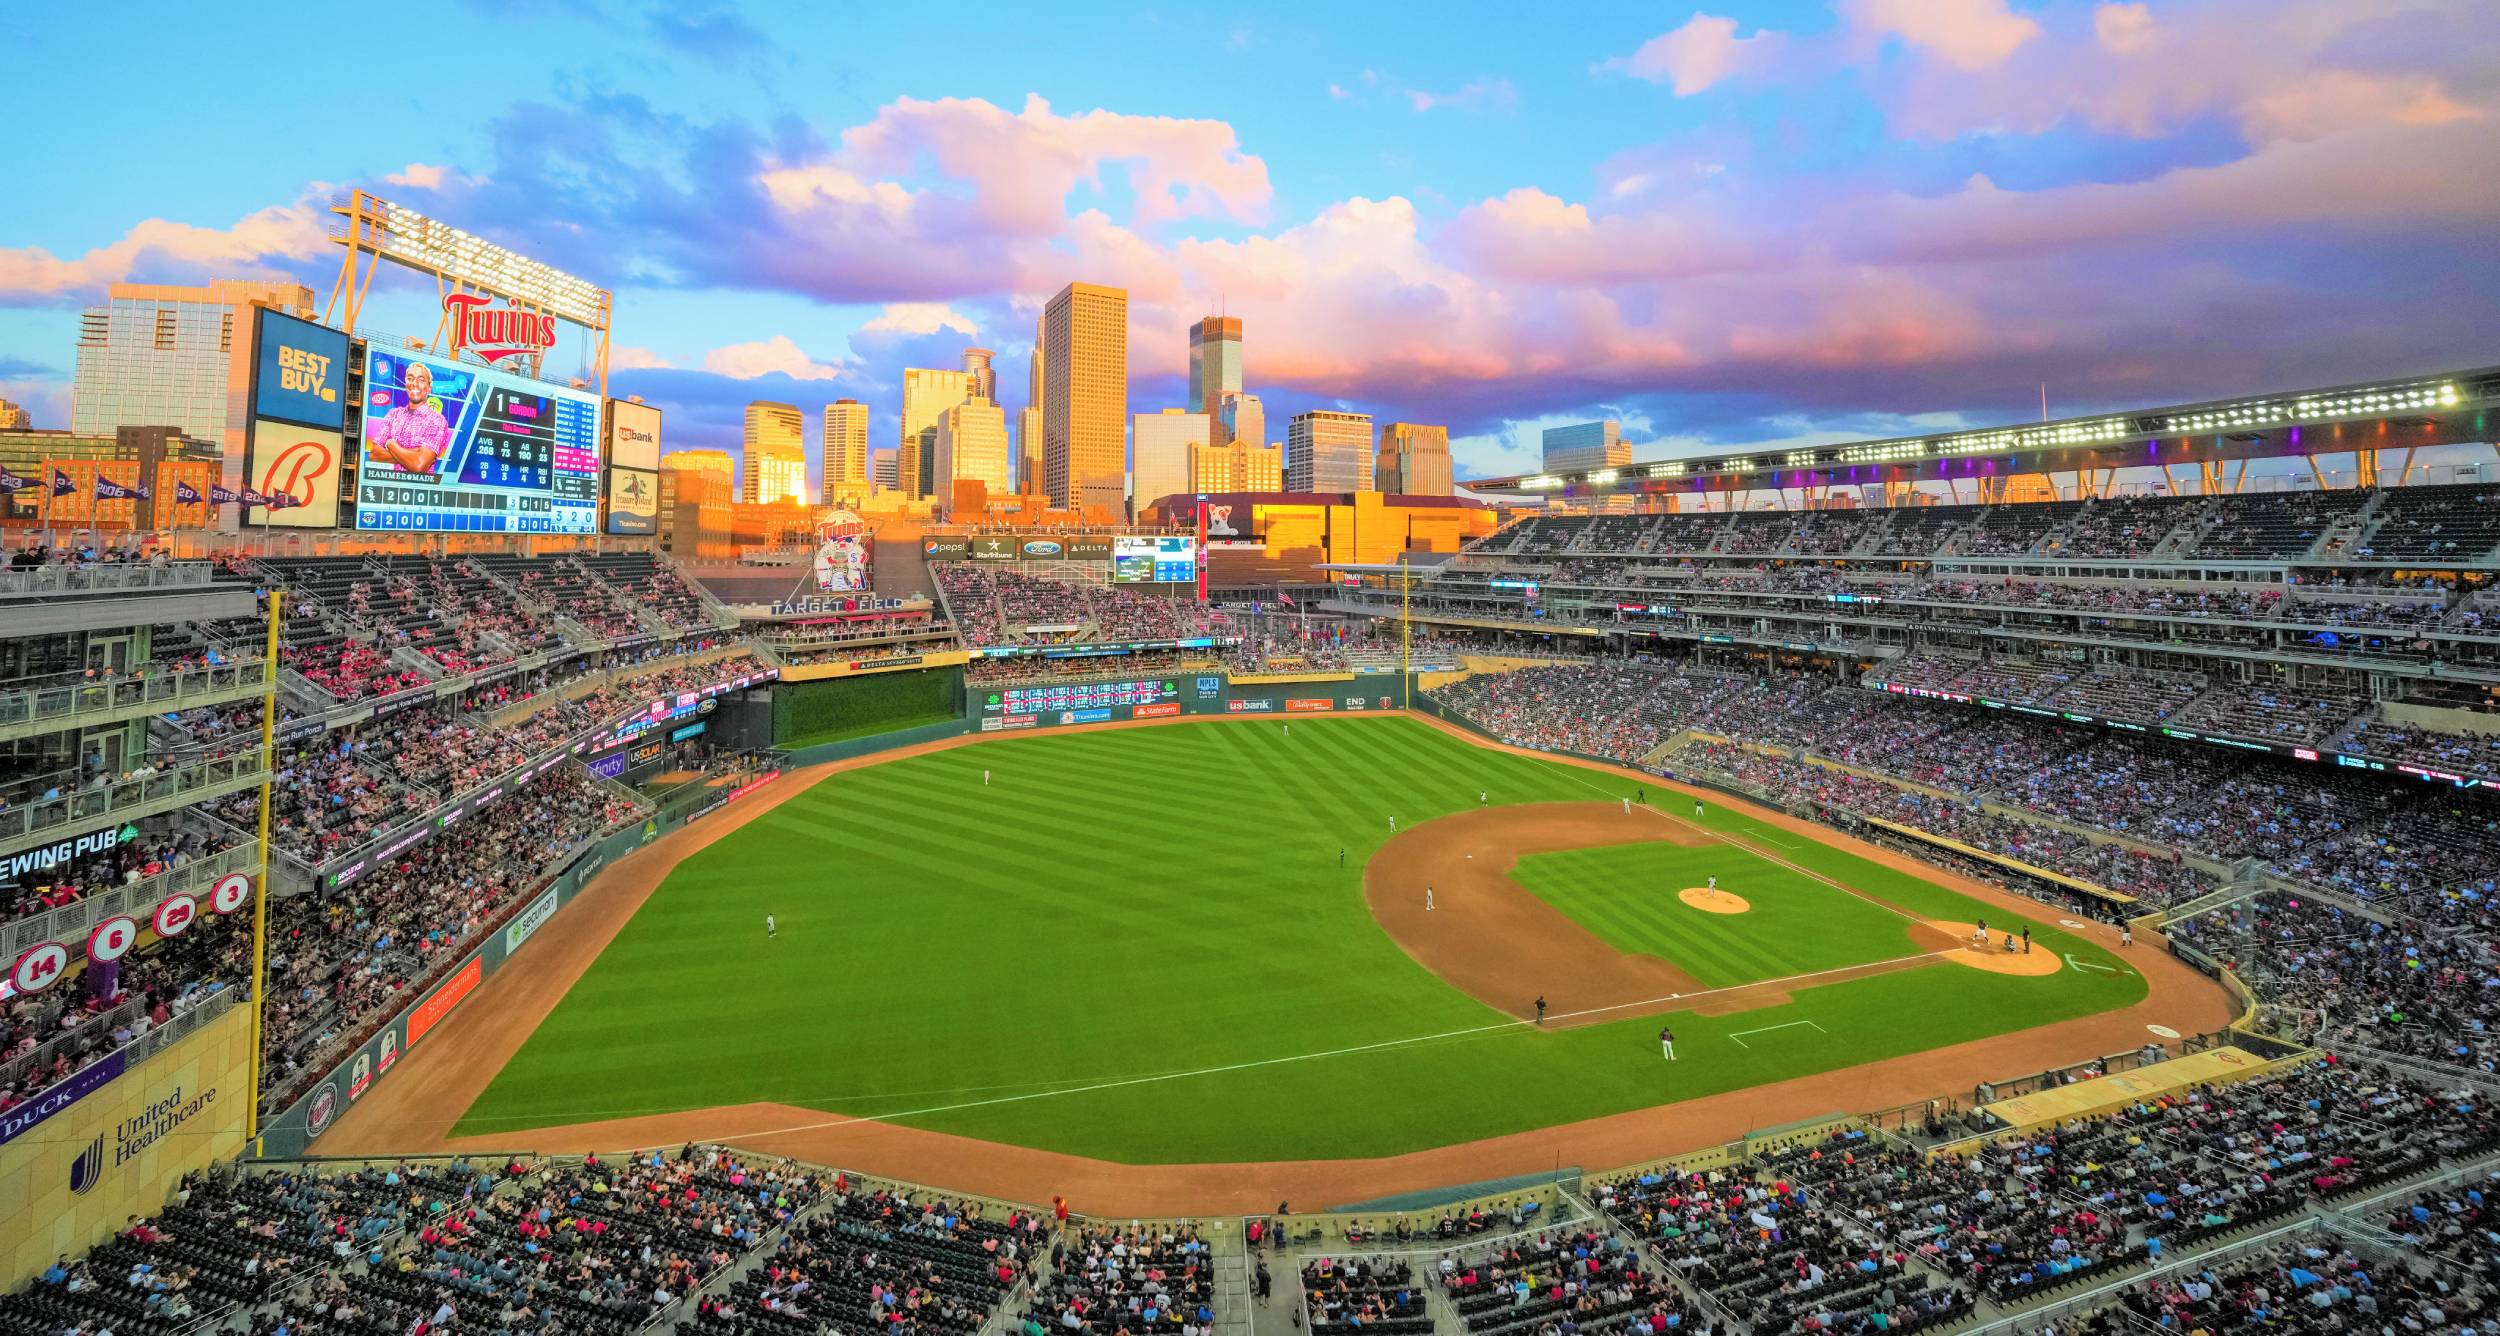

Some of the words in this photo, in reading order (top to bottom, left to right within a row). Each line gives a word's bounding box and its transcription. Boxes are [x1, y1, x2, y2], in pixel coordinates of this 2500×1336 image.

[443, 293, 556, 352] Twins
[278, 345, 330, 377] BEST
[281, 368, 325, 396] BUY
[497, 393, 503, 412] 1
[478, 438, 492, 446] AVG
[262, 442, 331, 511] B
[368, 470, 407, 480] HAMMER
[521, 474, 526, 482] 4
[98, 483, 125, 497] 2006
[388, 491, 394, 500] 2
[402, 492, 410, 502] 0
[418, 493, 424, 502] 0
[434, 494, 438, 504] 1
[522, 500, 528, 508] 6
[544, 501, 550, 509] 5
[386, 515, 392, 525] 2
[402, 516, 408, 526] 0
[416, 516, 424, 526] 0
[521, 520, 526, 528] 3
[544, 521, 548, 529] 5
[556, 511, 562, 521] 3
[572, 512, 577, 521] 2
[586, 512, 592, 522] 0
[818, 520, 864, 544] Twins
[939, 543, 965, 552] pepsi
[1031, 544, 1054, 552] Ford
[773, 601, 841, 614] TARGET
[859, 598, 904, 610] FIELD
[291, 729, 304, 740] Run
[305, 724, 322, 736] Porch
[640, 742, 660, 759] SOLAR
[376, 828, 428, 861] securian.com/careers
[0, 842, 72, 880] EWING
[76, 829, 117, 858] PUB
[338, 861, 364, 880] securian
[228, 886, 238, 903] 3
[166, 905, 190, 928] 29
[522, 896, 554, 931] securian
[109, 930, 122, 950] 6
[30, 955, 56, 982] 14
[4, 1087, 72, 1137] DUCK
[116, 1086, 181, 1142] United
[115, 1087, 216, 1168] Healthcare
